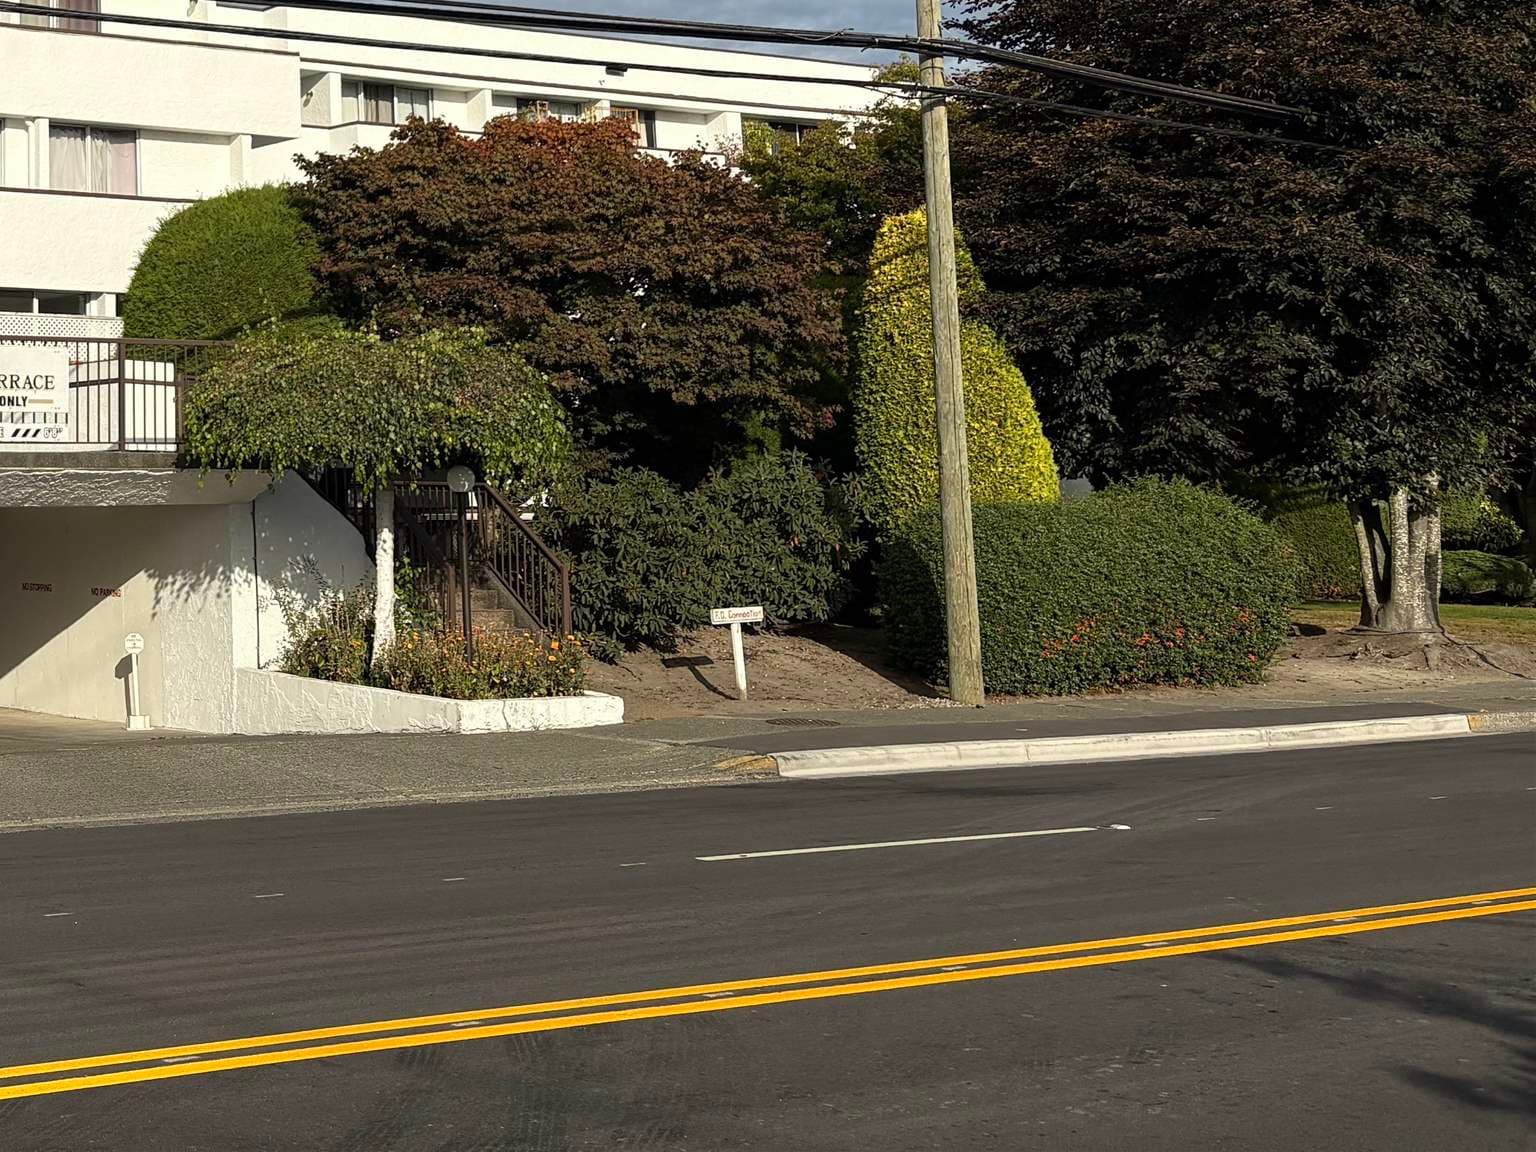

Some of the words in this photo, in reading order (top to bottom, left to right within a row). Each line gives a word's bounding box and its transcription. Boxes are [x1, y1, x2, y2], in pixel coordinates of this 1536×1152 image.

[0, 395, 28, 407] ONLY
[22, 582, 29, 591] NO
[91, 587, 99, 596] NO
[100, 588, 121, 598] PARKING
